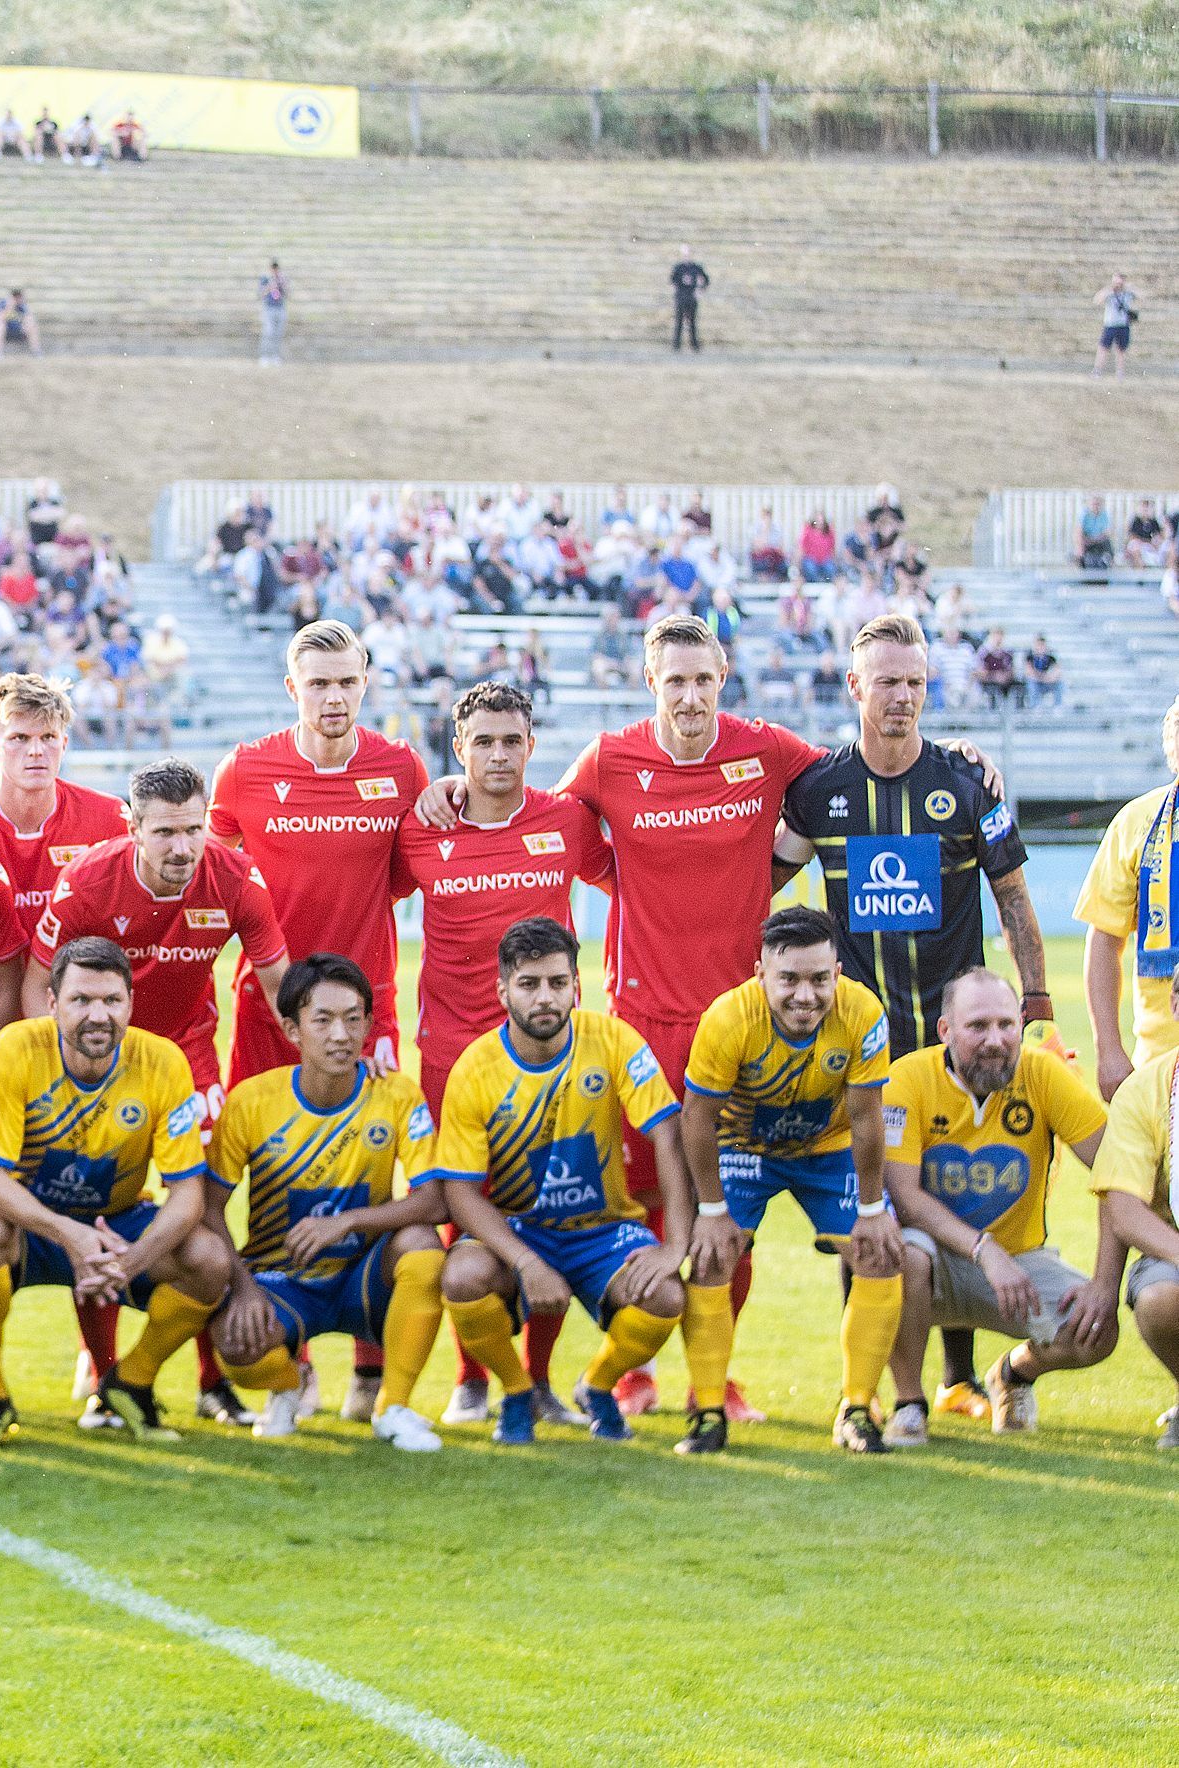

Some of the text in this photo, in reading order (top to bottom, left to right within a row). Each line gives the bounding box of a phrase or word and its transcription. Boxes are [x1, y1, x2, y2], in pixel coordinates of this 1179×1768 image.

[265, 816, 400, 833] AROUNDTOWN
[633, 797, 763, 829] AROUNDTOWN
[433, 870, 565, 896] AROUNDTOWN
[854, 893, 935, 917] UNIQA
[122, 945, 223, 964] OUNDTOWN
[924, 1160, 1022, 1195] 1894
